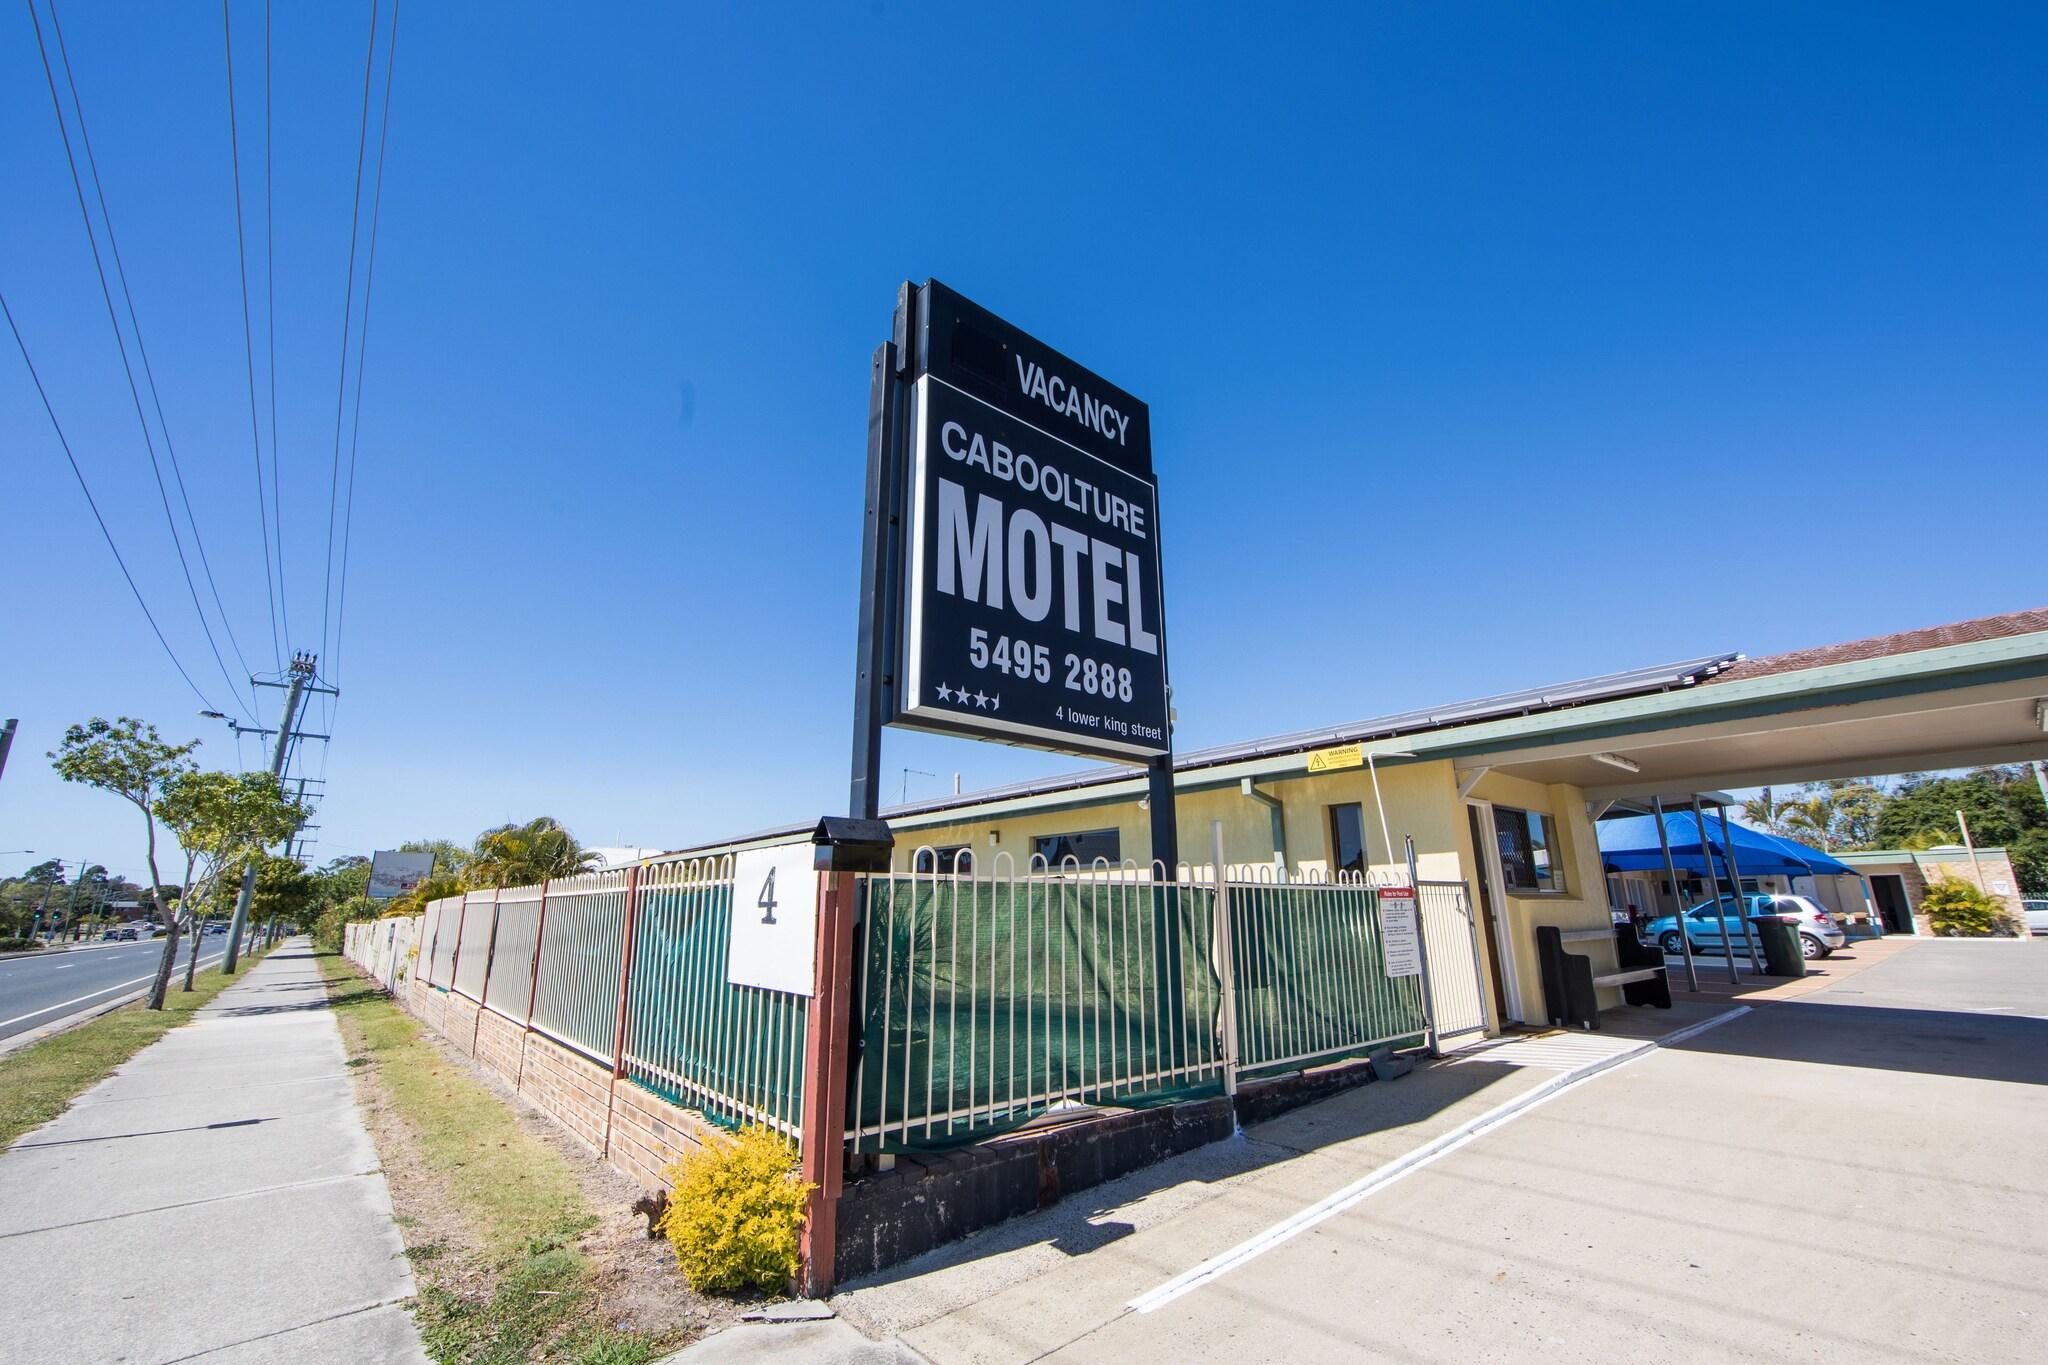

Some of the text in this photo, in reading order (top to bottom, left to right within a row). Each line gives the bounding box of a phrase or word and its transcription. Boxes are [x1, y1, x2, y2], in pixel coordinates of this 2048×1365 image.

[1017, 355, 1128, 446] VACANCY
[942, 421, 1146, 539] CABOOLTURE
[937, 477, 1157, 655] MOTEL
[970, 628, 1132, 703] 5495 2888
[1055, 705, 1162, 740] 4 lower king street
[1328, 746, 1358, 756] WARNING
[757, 866, 778, 925] 4
